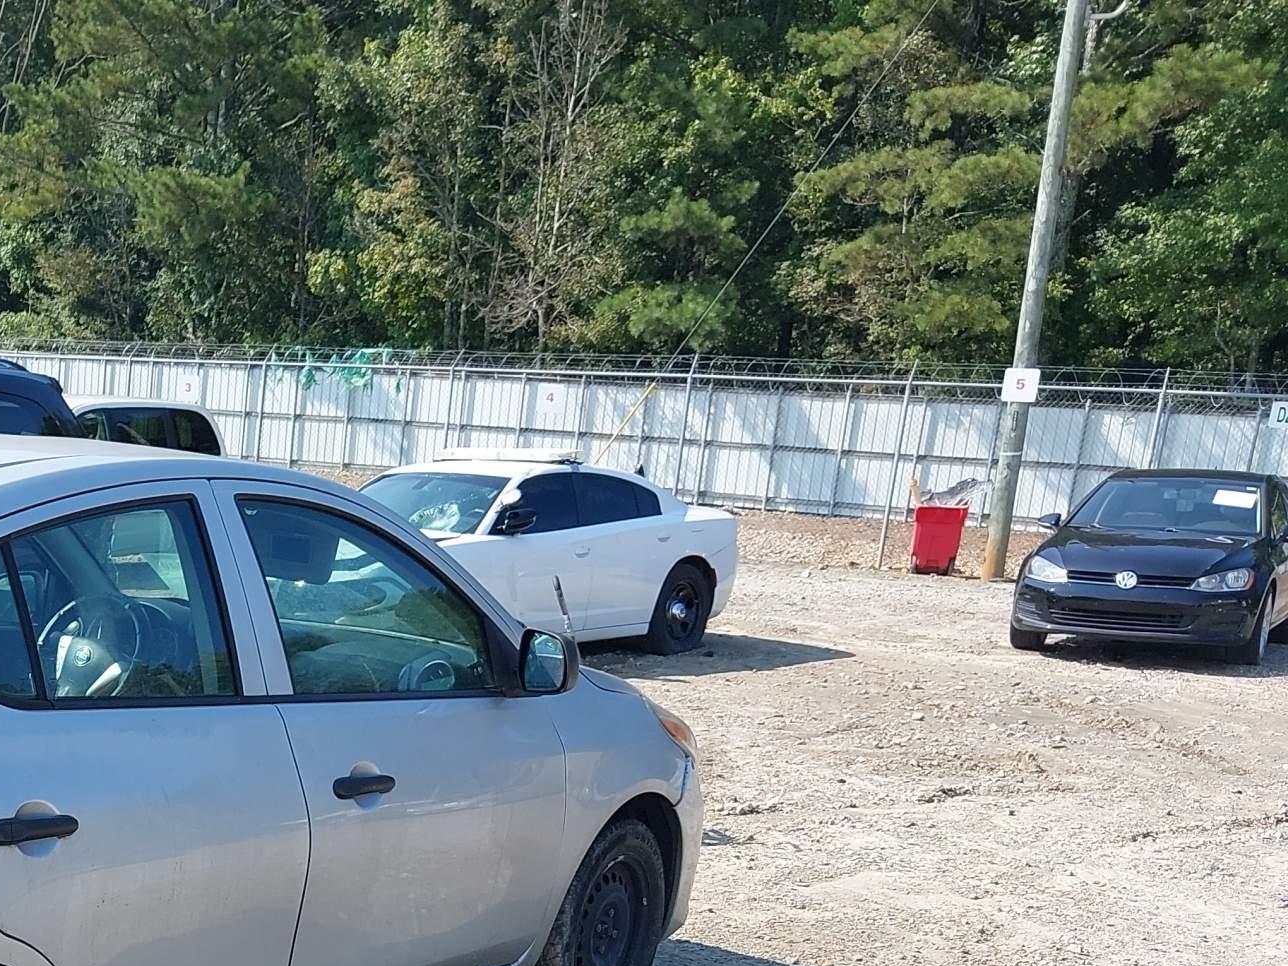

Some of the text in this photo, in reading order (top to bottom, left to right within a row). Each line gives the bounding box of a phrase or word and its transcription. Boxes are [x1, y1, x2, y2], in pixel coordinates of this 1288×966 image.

[184, 382, 192, 393] 3
[1015, 378, 1027, 391] 5
[545, 392, 554, 403] 4
